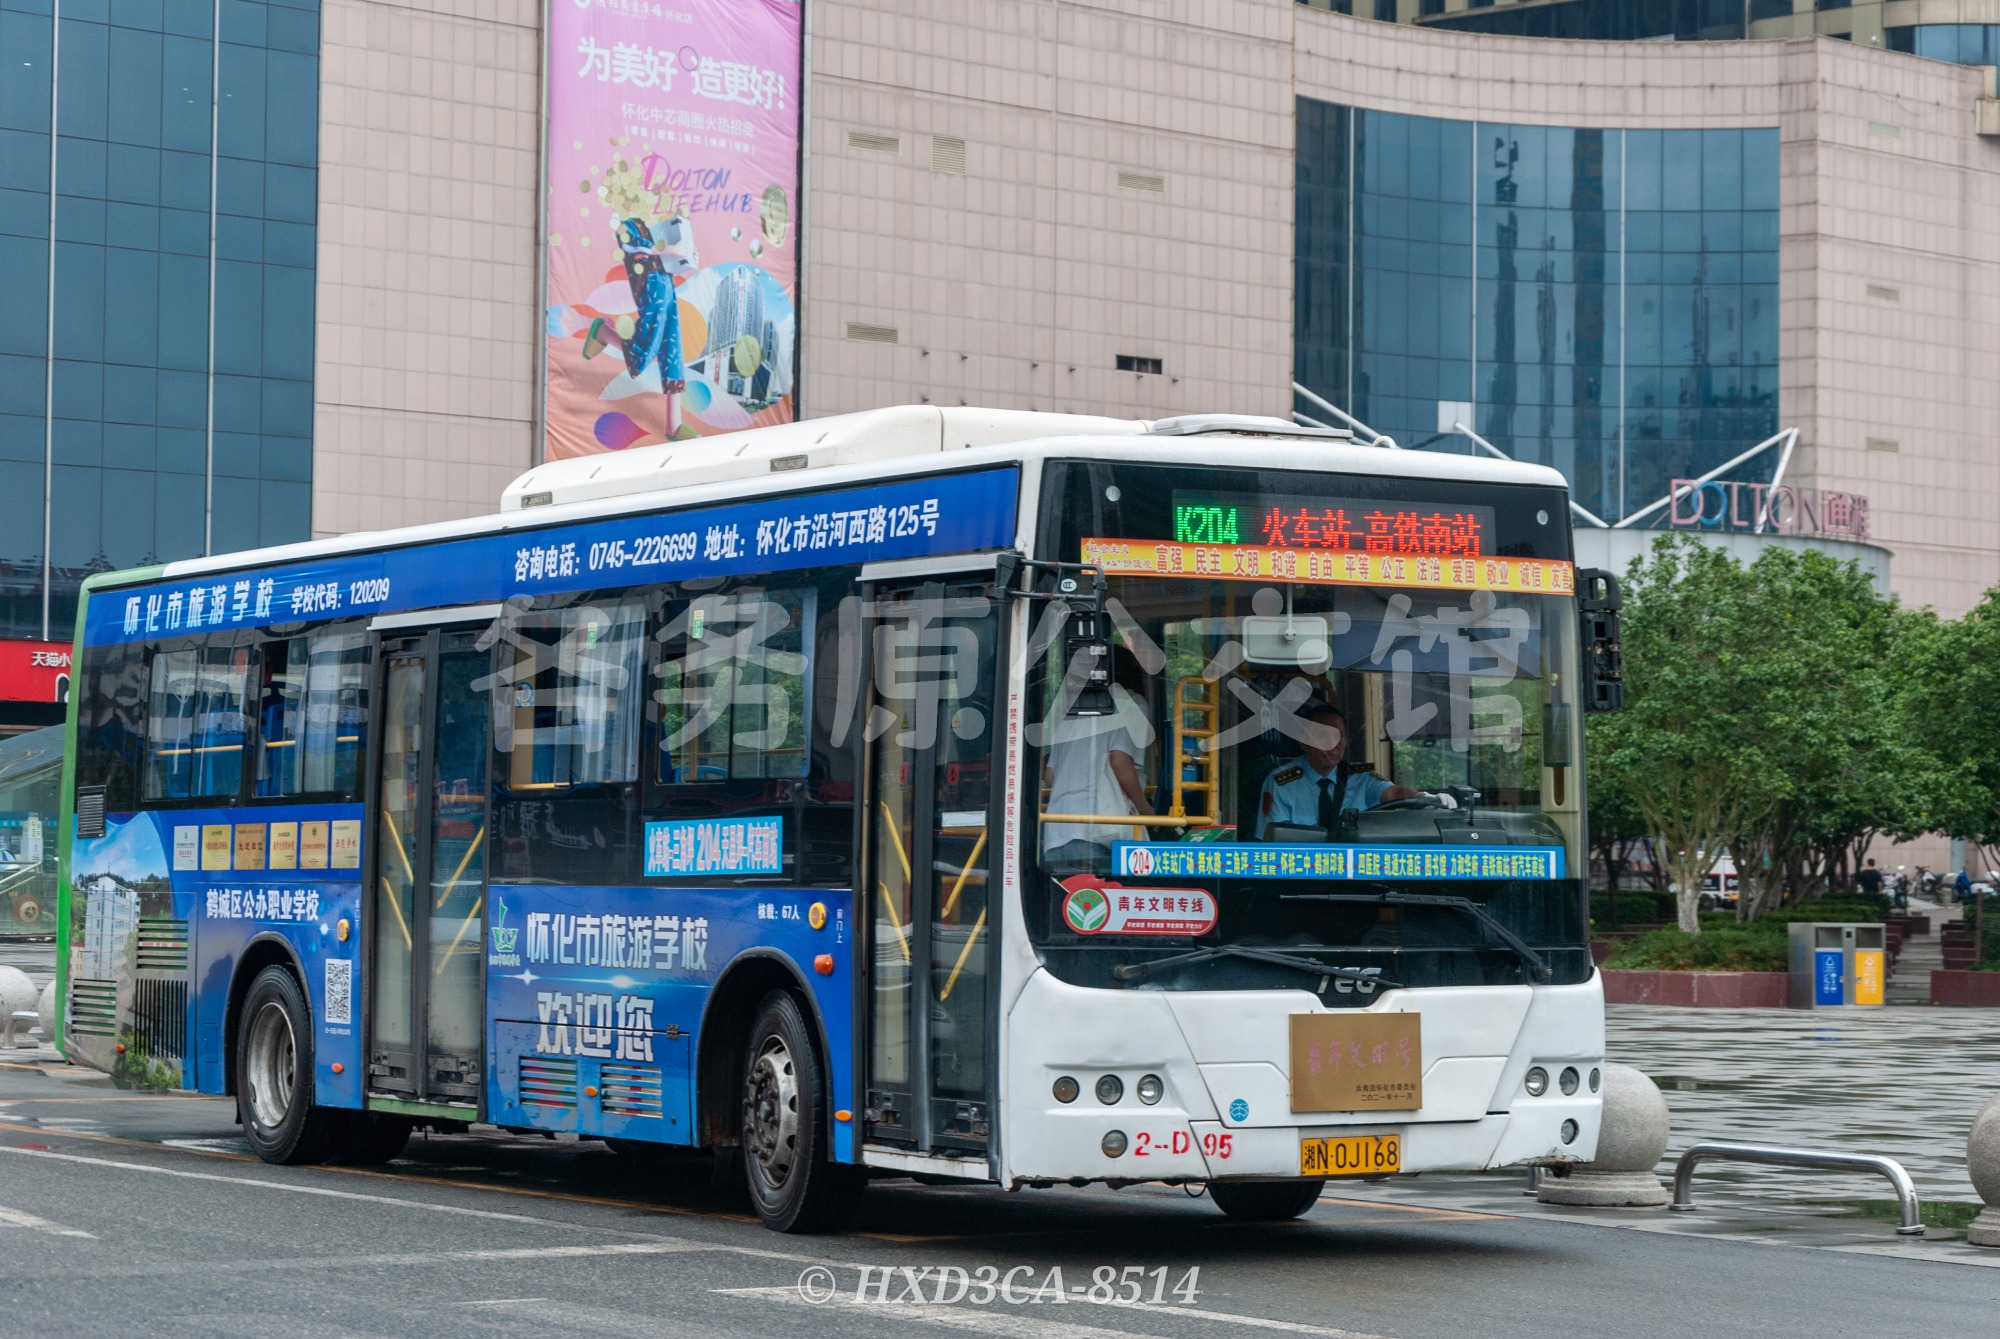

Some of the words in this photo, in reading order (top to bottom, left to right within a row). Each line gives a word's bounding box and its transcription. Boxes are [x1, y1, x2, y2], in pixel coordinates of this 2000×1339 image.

[577, 36, 678, 92] 为美好
[621, 102, 754, 138] 怀化中芯商圈火热招商
[641, 152, 732, 192] DOLTON
[652, 192, 752, 215] LIFEHUB
[1176, 506, 1239, 544] K204
[1670, 479, 1819, 531] DOLTON
[590, 531, 697, 571] 0745-2226699
[756, 498, 940, 557] 怀化市沿河西路125号
[1089, 543, 1130, 554] 社会主义
[1262, 506, 1481, 557] 火车站-高铁南站
[1155, 545, 1183, 574] 富强
[1194, 547, 1222, 574] 民主
[1233, 548, 1259, 577] 文明
[1271, 550, 1296, 579] 和谐
[1308, 553, 1333, 580] 自由
[1344, 553, 1370, 582] 平等
[1380, 555, 1406, 581] 公正
[1416, 557, 1441, 583] 法治
[1452, 558, 1477, 585] 爱国
[1486, 559, 1510, 586] 敬业
[1519, 562, 1543, 588] 诚信
[1551, 561, 1573, 591] 友善
[123, 578, 274, 635] 怀化市旅游学校
[350, 577, 390, 605] 120209
[31, 651, 73, 667] 天猫小
[696, 823, 721, 871] 204
[1133, 851, 1150, 874] 204
[206, 888, 320, 921] 鹤城区公办职业学校
[781, 904, 800, 920] 67人
[1118, 896, 1203, 913] 青年文明专线
[526, 912, 709, 972] 怀化市旅游学校
[536, 990, 655, 1062] 欢迎您
[1308, 1035, 1413, 1075] 青年文明号
[1356, 1083, 1416, 1093] 共青团怀化市委员会
